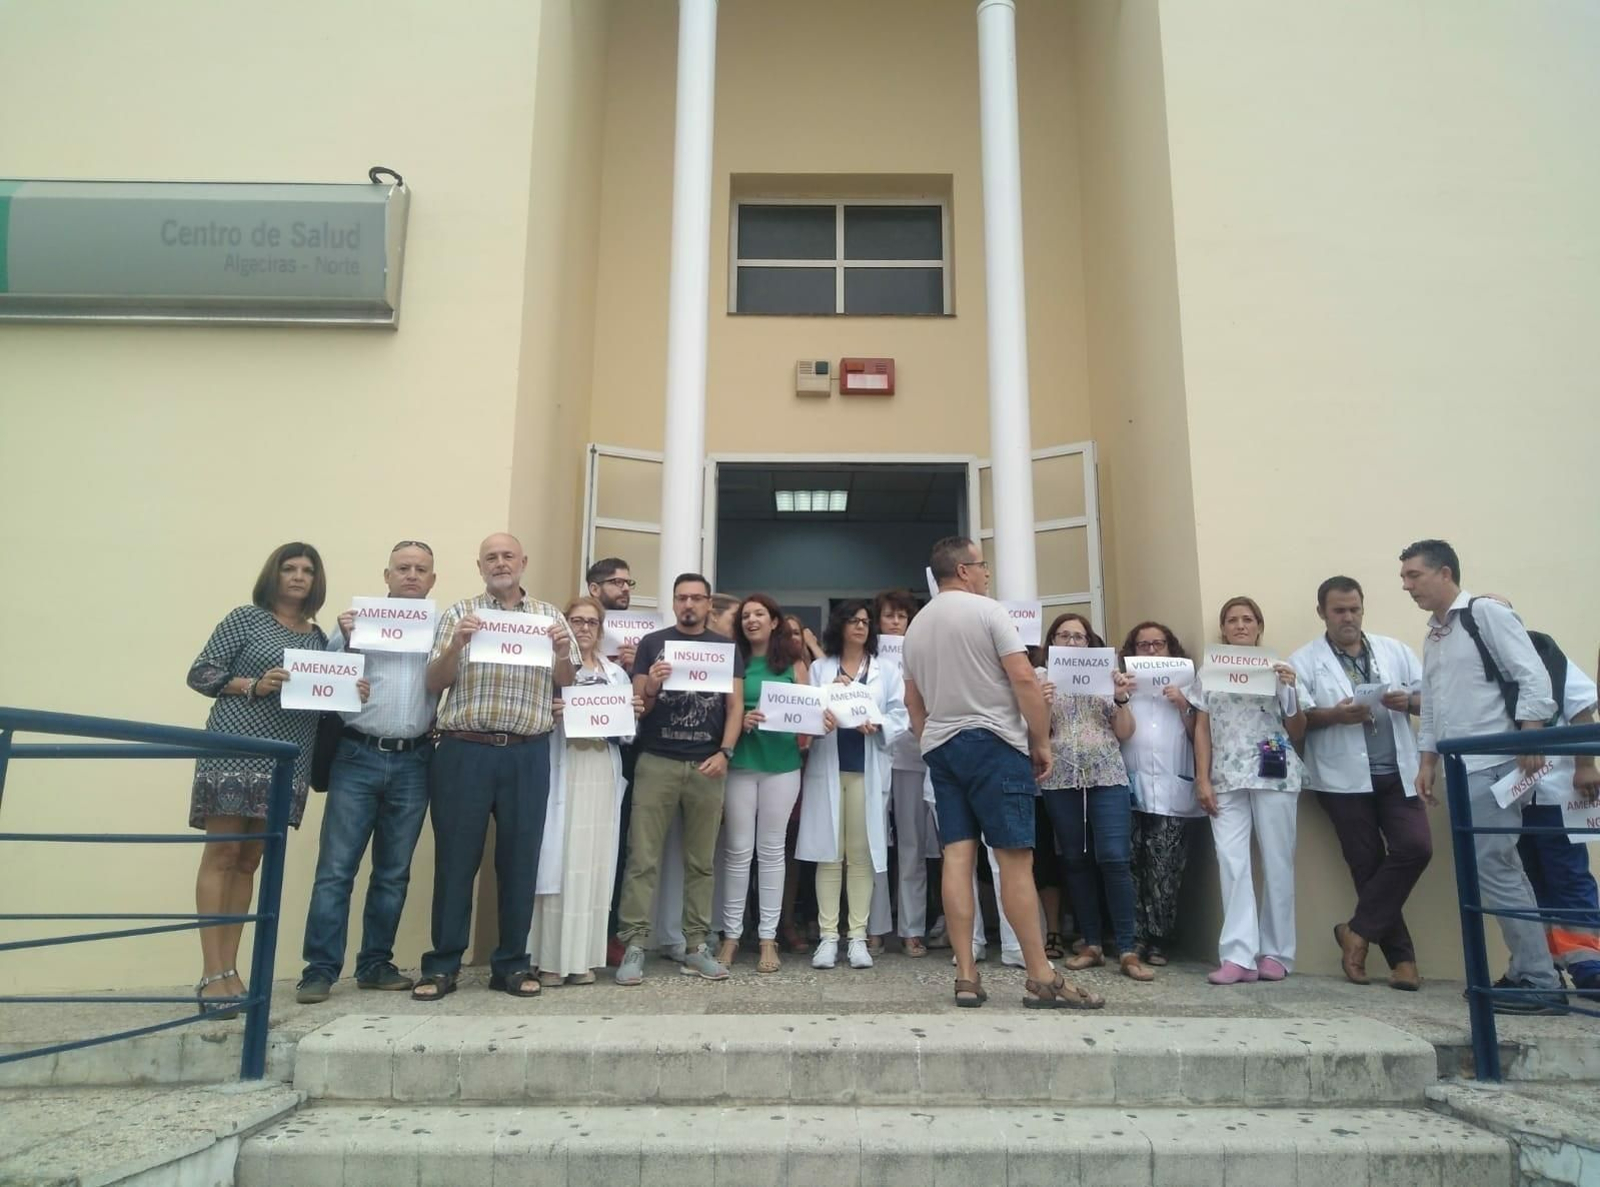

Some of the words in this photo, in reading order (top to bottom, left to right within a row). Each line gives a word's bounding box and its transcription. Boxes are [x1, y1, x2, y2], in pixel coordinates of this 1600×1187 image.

[161, 219, 242, 247] Centro
[251, 220, 281, 247] de
[291, 220, 361, 249] Salud
[224, 254, 297, 277] Algeciras
[315, 256, 361, 275] Norte
[358, 607, 428, 620] AMENAZAS
[1008, 609, 1036, 619] CCION
[479, 621, 548, 636] AMENAZAS
[607, 620, 655, 630] INSULTOS
[381, 627, 404, 640] NO
[624, 636, 641, 646] NO
[500, 642, 523, 655] NO
[881, 644, 903, 654] AME
[673, 651, 725, 663] INSULTOS
[1053, 657, 1110, 668] AMENAZAS
[1210, 654, 1269, 667] VIOLENCIA
[290, 661, 358, 677] AMENAZAS
[1131, 660, 1188, 670] VIOLENCIA
[688, 670, 708, 681] NO
[1072, 674, 1091, 685] NO
[1152, 676, 1171, 686] NO
[1229, 672, 1249, 684] NO
[311, 684, 335, 697] NO
[571, 695, 626, 707] COACCION
[767, 693, 821, 707] VIOLENCIA
[851, 705, 867, 716] NO
[590, 714, 610, 726] NO
[783, 713, 802, 724] NO
